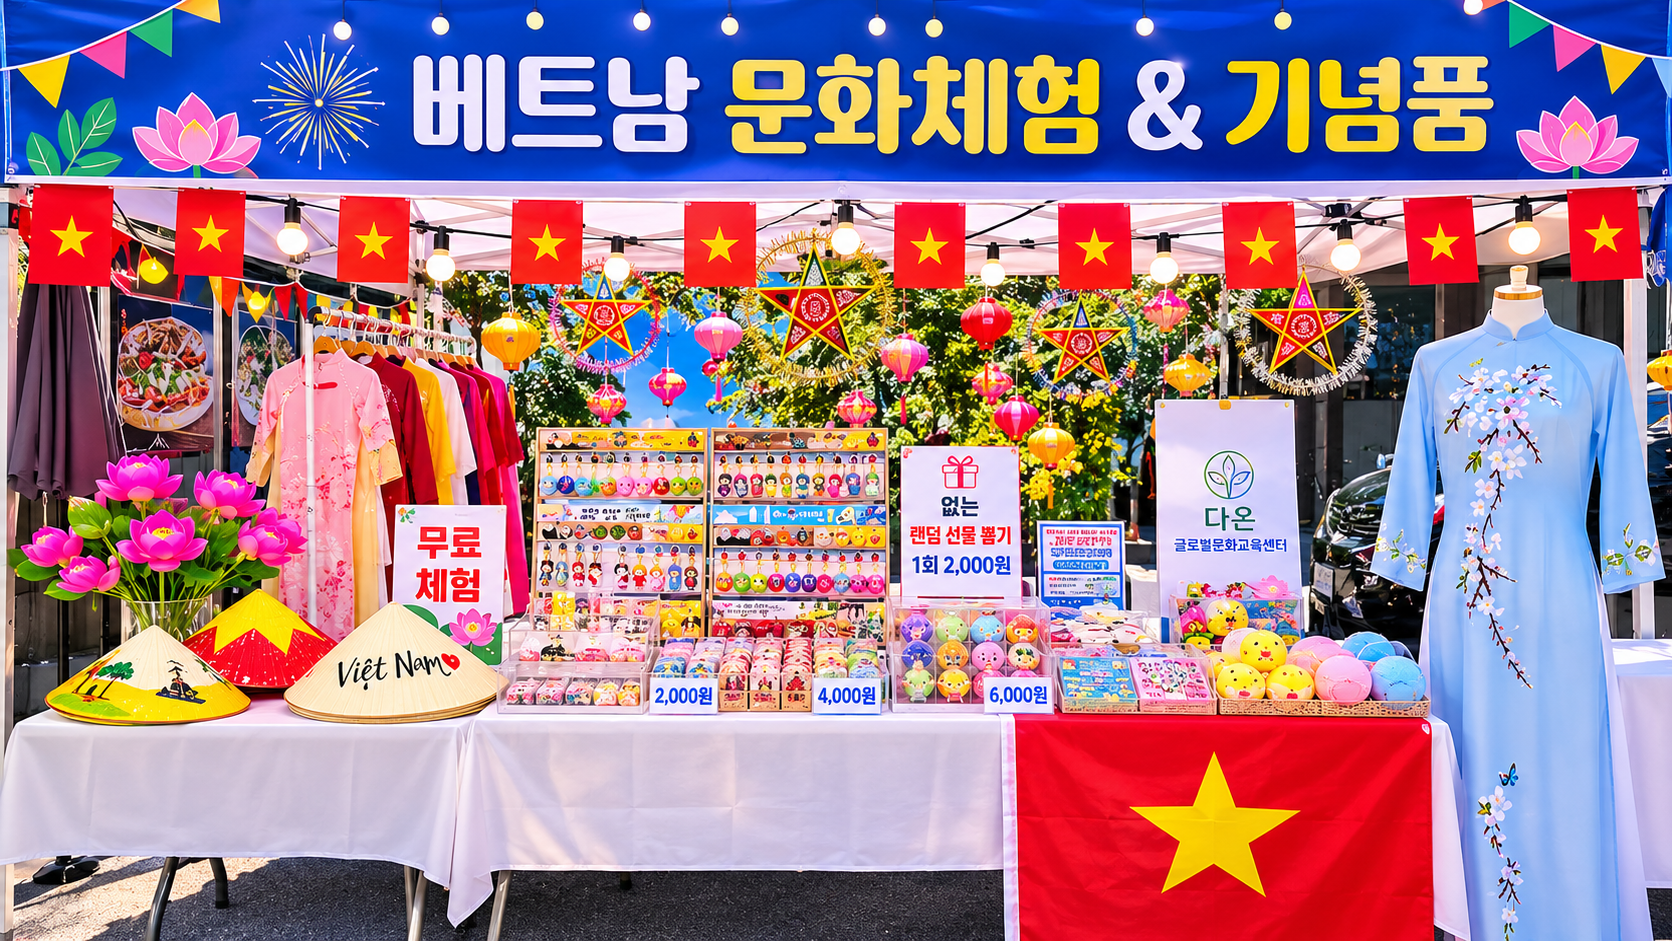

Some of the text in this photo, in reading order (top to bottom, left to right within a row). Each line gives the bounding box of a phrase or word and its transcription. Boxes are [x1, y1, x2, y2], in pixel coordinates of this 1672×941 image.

[411, 53, 1495, 156] 베트남 문화체험 & 기념품
[941, 495, 979, 517] 없는
[1204, 506, 1256, 532] 다온
[417, 526, 482, 559] 무료
[909, 525, 1012, 546] 랜덤 선물 뽑기
[1173, 537, 1288, 553] 글로벌문화교육센터
[911, 554, 1012, 577] 1회 2,000원
[415, 568, 480, 603] 체험
[338, 650, 451, 691] Việt Nam
[654, 686, 713, 706] 2,000원
[817, 686, 876, 706] 4,000원
[989, 685, 1049, 705] 6,000원
